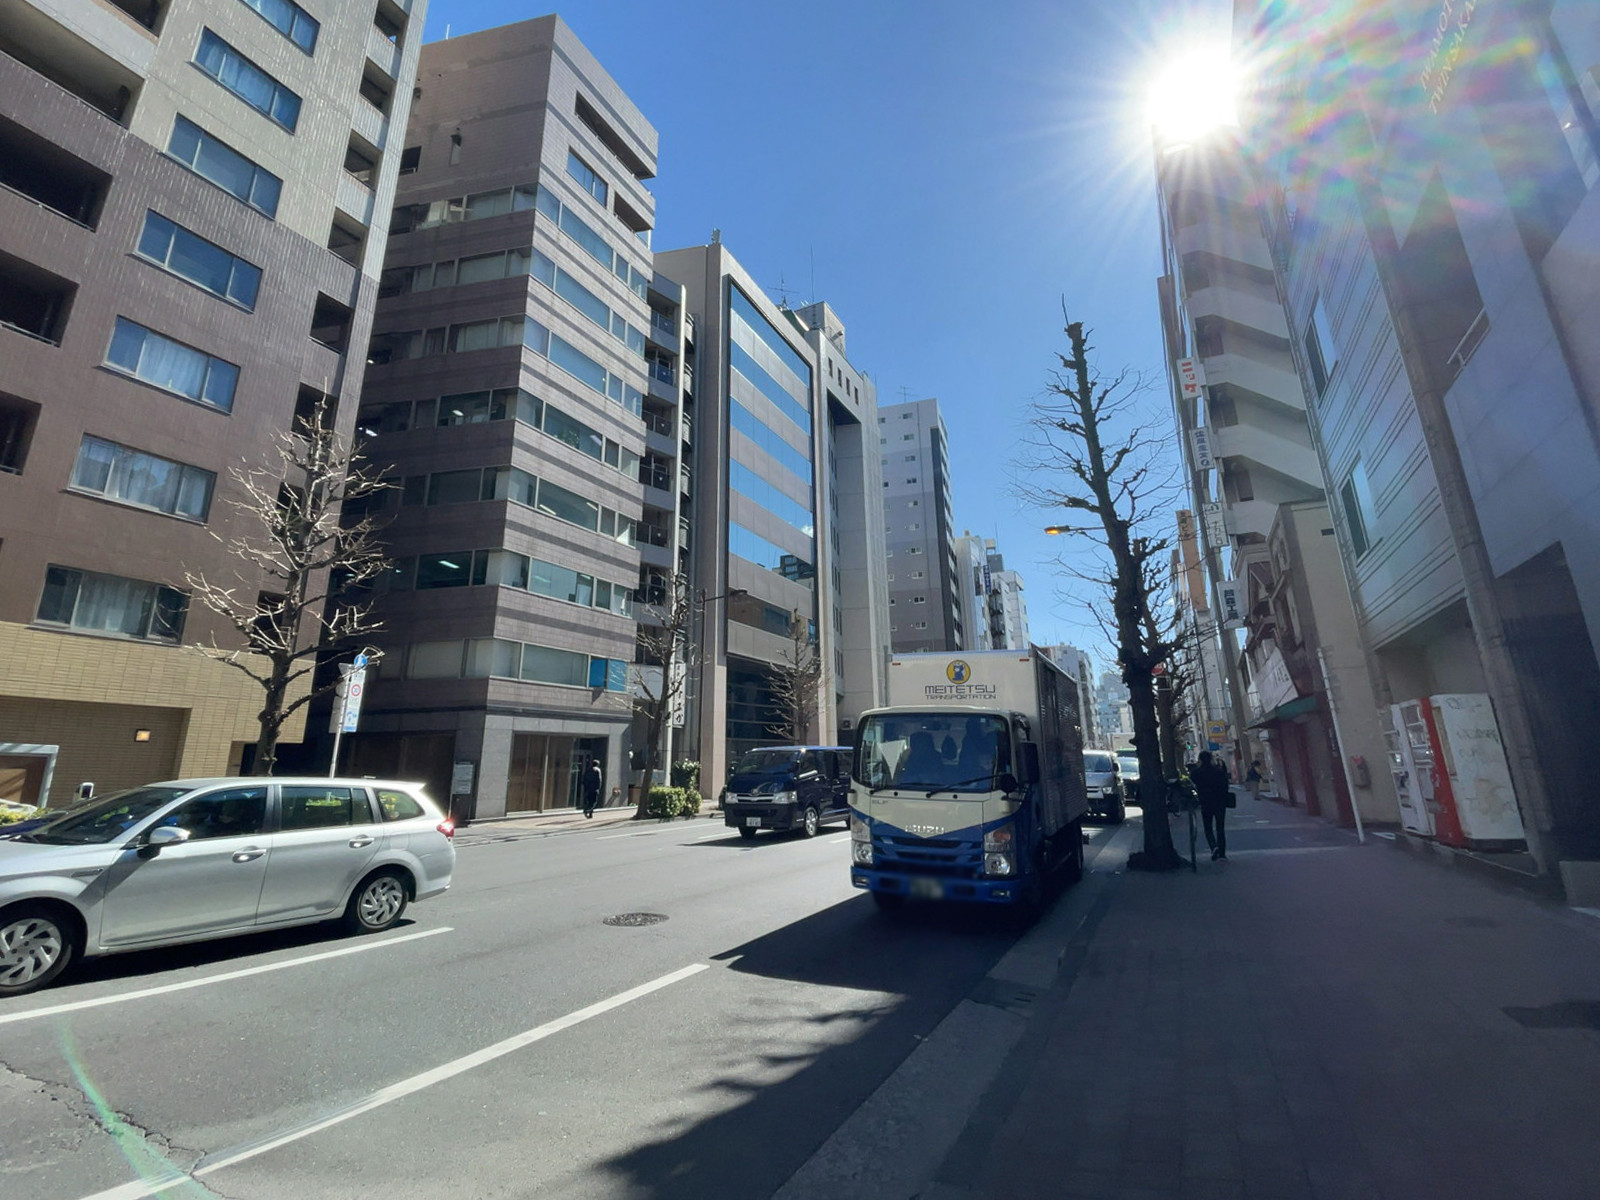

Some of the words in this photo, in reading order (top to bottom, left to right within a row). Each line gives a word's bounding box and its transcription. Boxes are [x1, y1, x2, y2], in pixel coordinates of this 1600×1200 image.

[1420, 0, 1452, 91] IWAMOT
[1449, 0, 1476, 62] SAKA
[924, 684, 996, 694] MEITETSU
